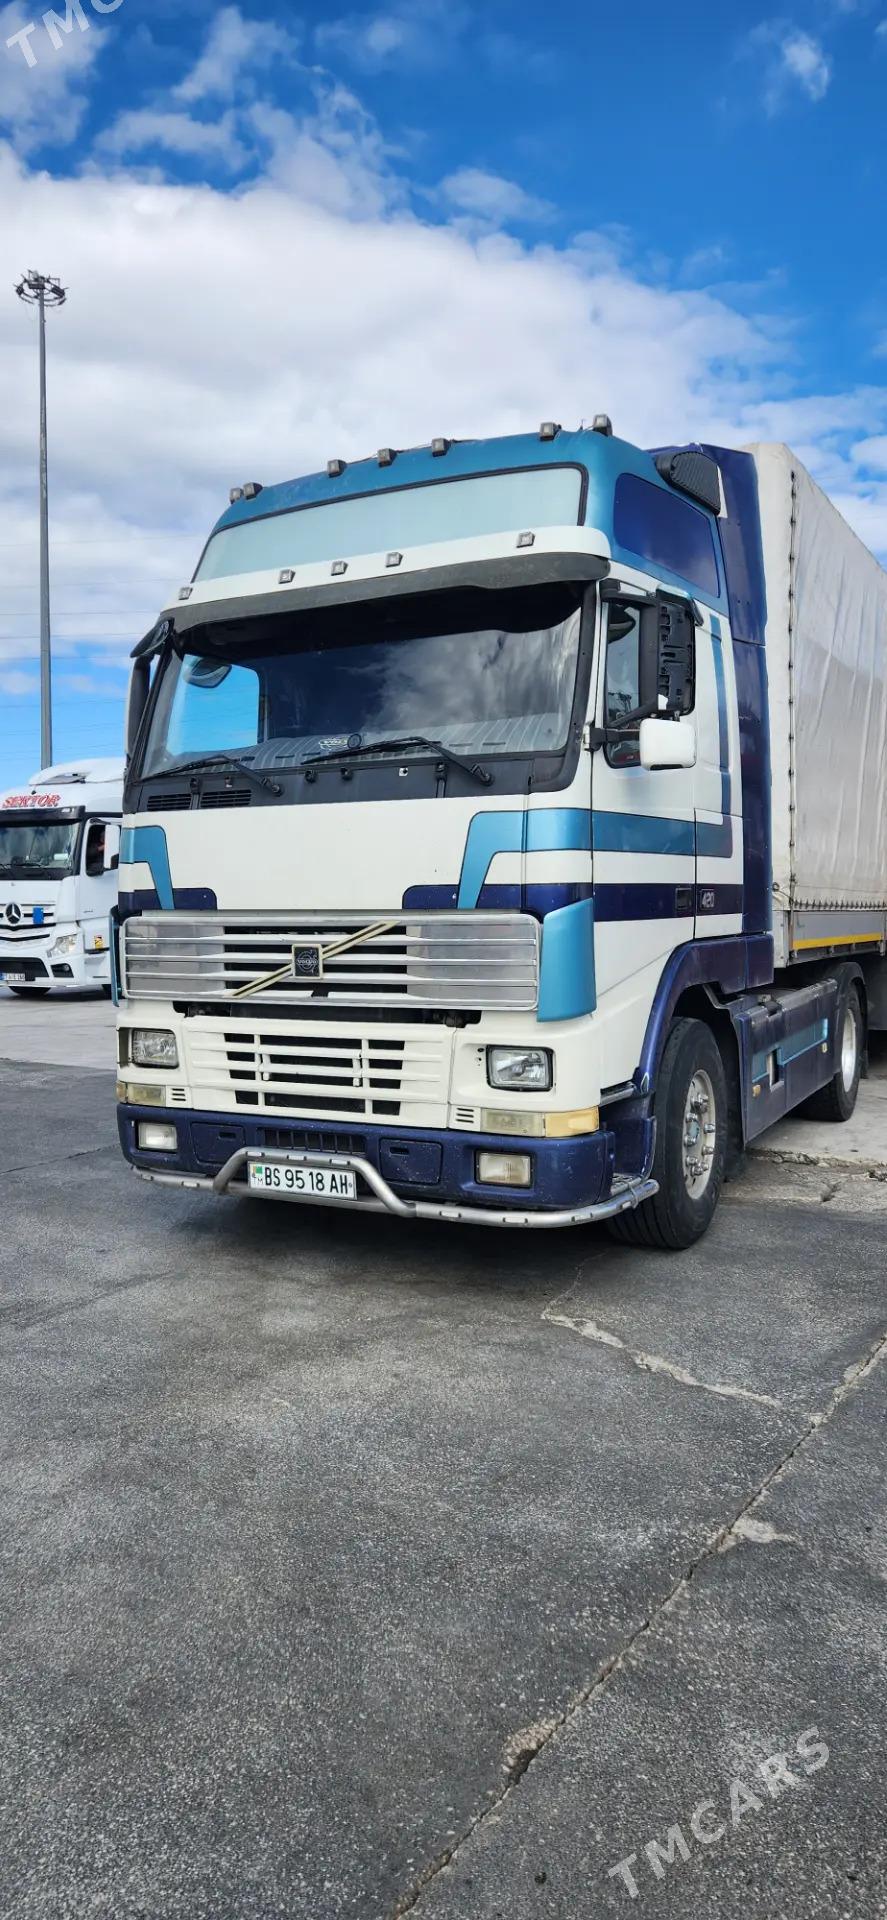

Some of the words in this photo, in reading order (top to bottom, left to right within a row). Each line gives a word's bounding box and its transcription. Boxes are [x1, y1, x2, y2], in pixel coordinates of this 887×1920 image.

[701, 891, 715, 908] 420
[265, 1167, 281, 1187] BS
[329, 1173, 348, 1194] AH
